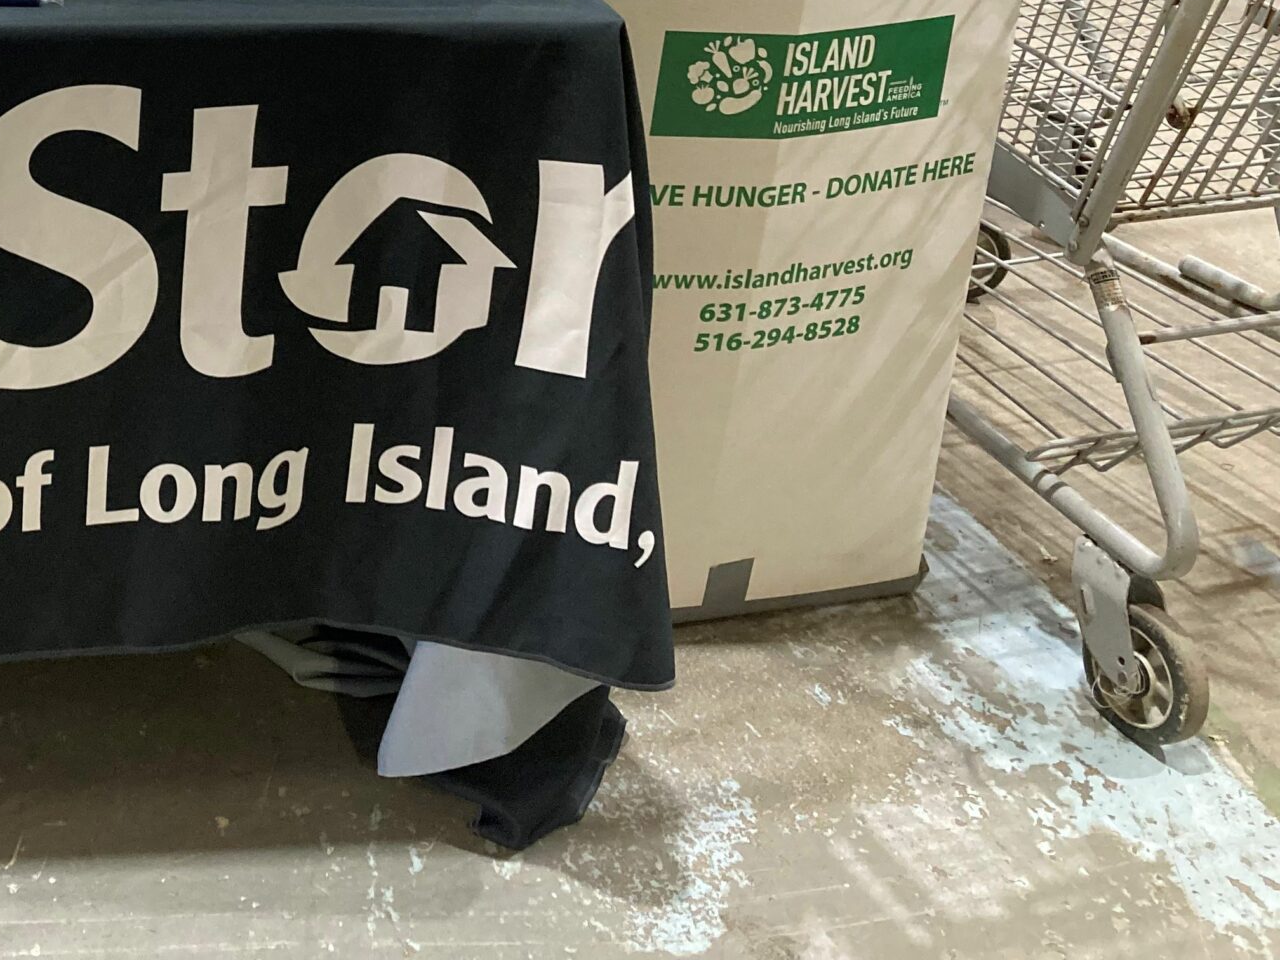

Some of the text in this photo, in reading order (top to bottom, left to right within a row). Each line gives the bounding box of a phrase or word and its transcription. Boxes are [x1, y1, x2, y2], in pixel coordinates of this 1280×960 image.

[783, 34, 876, 77] ISLAND
[776, 69, 892, 116] HARVEST
[886, 92, 921, 102] AMERICA
[888, 83, 922, 94] FEEDING
[772, 105, 919, 135] Nourishing Long Island's Future
[685, 182, 807, 208] HUNGER
[826, 164, 918, 200] DONATE
[922, 152, 976, 183] HERE
[652, 247, 914, 290] www.islandharvest.org
[699, 284, 866, 323] 631-873-4775
[693, 315, 861, 352] 516-294-8528
[85, 444, 310, 531] Long
[344, 422, 657, 569] Island,
